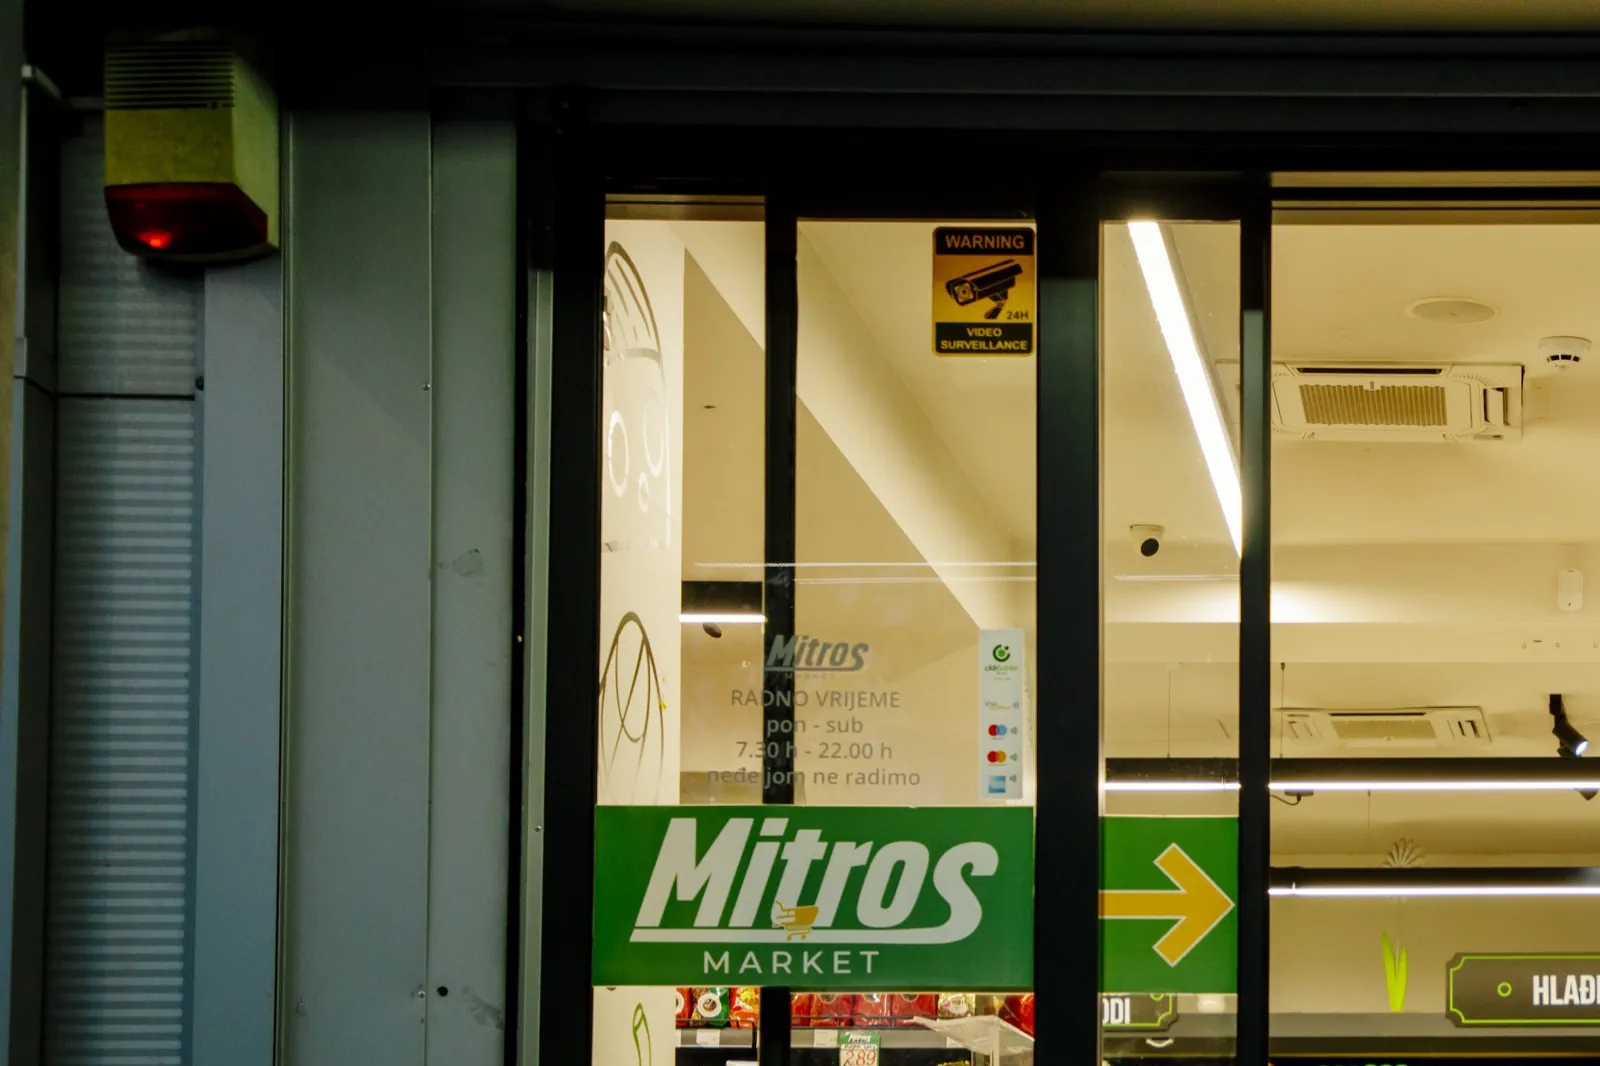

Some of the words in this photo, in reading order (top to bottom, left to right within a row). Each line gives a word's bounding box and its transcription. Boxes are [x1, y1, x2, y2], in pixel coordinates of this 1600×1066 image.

[945, 235, 1025, 249] WARNING
[1006, 311, 1029, 320] 24H
[966, 328, 1002, 337] VIDEO
[941, 340, 1028, 350] SURVEILLANCE
[765, 634, 869, 672] Mitros
[731, 689, 809, 707] RADNO
[816, 690, 901, 711] VRIJEME
[766, 719, 806, 738] pon
[826, 717, 864, 734] sub
[785, 740, 797, 759] h
[818, 742, 874, 760] 22.00
[880, 742, 893, 760] h
[813, 770, 839, 785] ne
[846, 767, 921, 786] radimo
[630, 817, 999, 945] Mitros
[703, 951, 880, 974] MARKET
